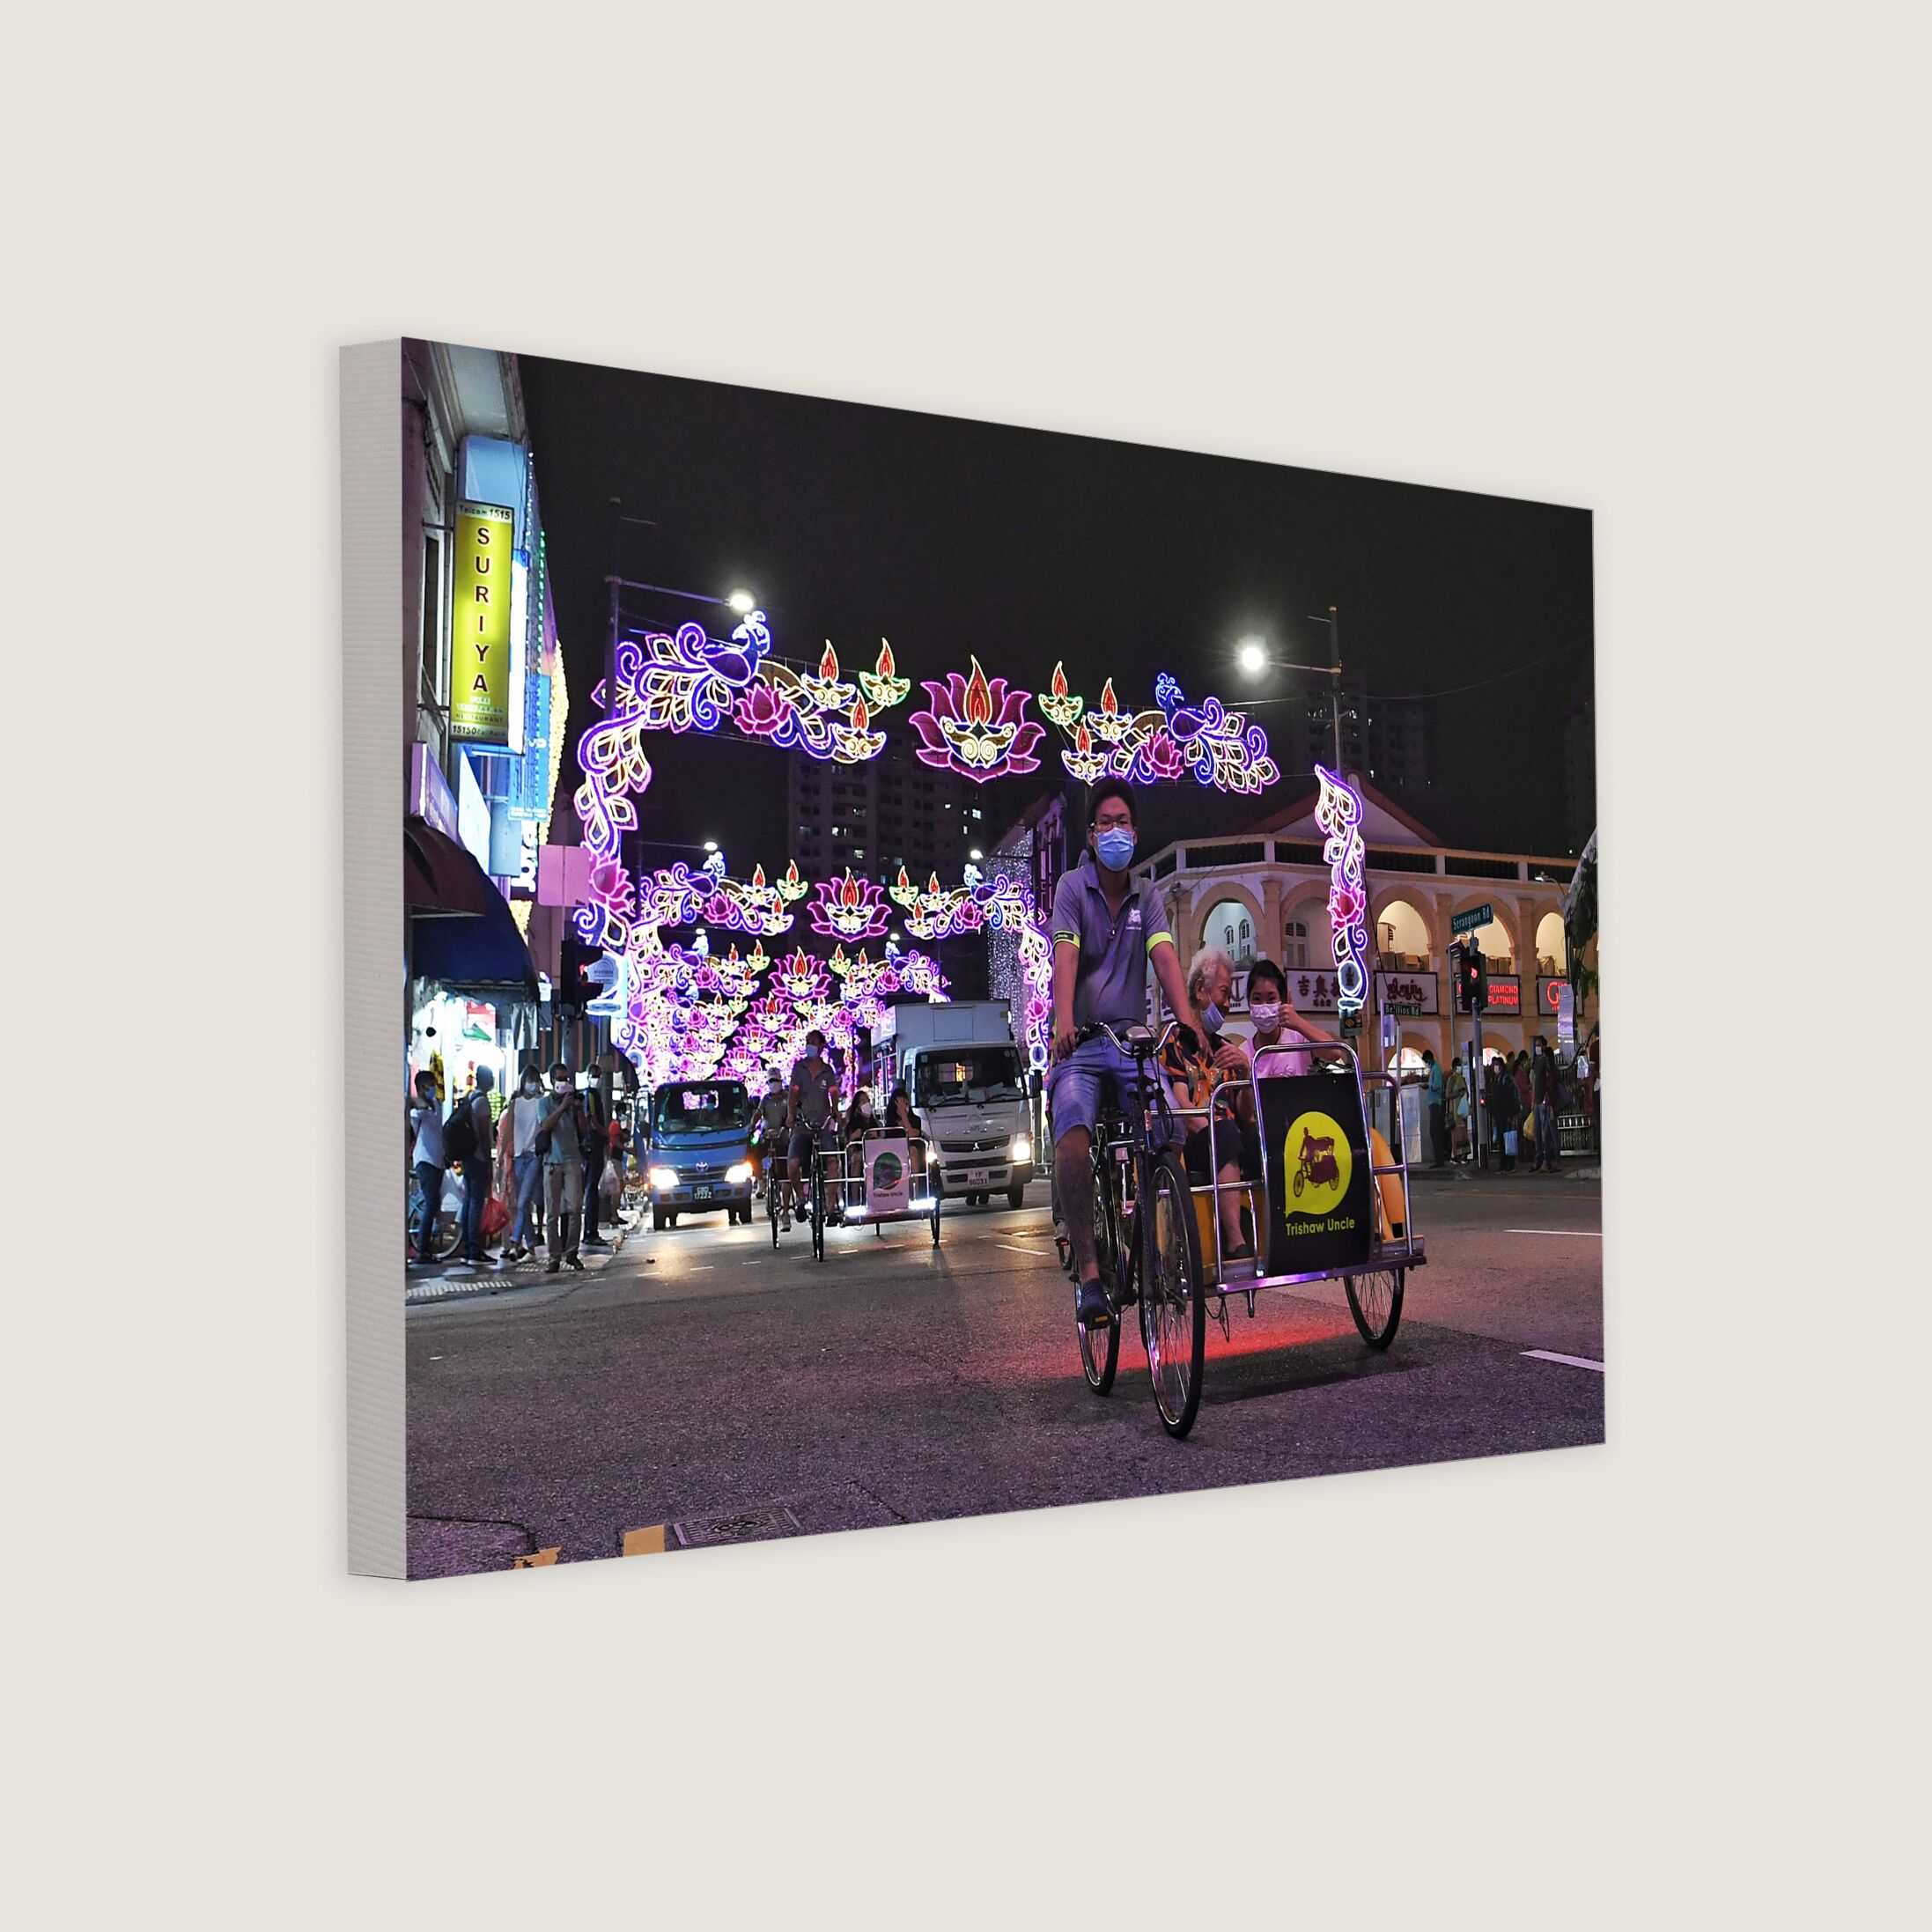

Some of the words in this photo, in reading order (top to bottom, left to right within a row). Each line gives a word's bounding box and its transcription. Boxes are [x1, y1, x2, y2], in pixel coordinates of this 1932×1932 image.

[490, 508, 511, 520] 1515
[473, 527, 490, 693] SURIYA
[1453, 912, 1481, 930] Serangoon
[1482, 905, 1490, 919] Rd
[1489, 984, 1518, 994] DIAMOND
[1487, 995, 1518, 1005] PLATINUM
[1411, 1007, 1420, 1015] Rd
[1286, 1221, 1324, 1236] Trishaw
[1327, 1216, 1355, 1232] Uncle
